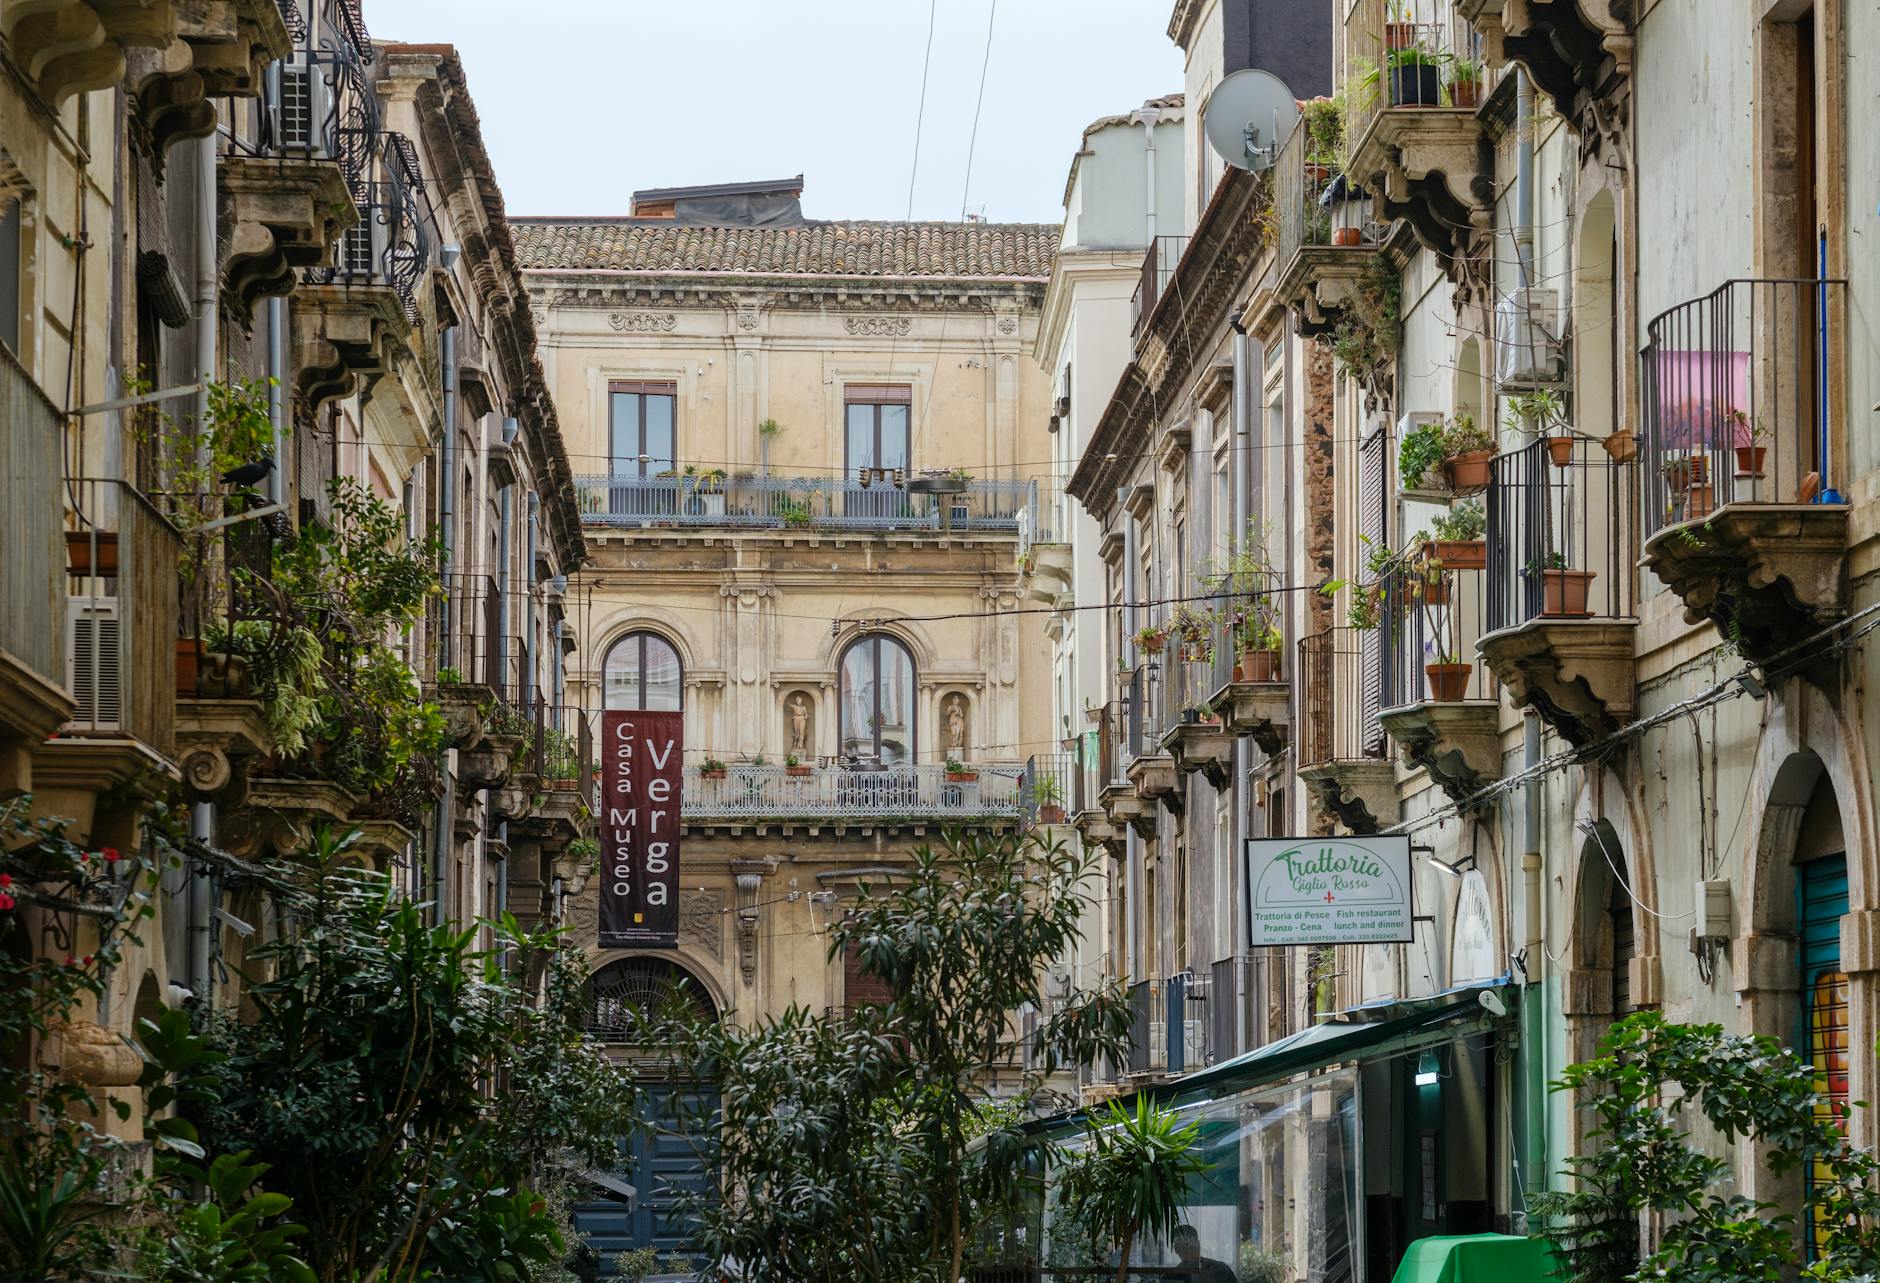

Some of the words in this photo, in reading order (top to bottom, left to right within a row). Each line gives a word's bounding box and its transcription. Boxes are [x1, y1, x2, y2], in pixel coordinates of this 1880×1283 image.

[616, 722, 635, 793] Casa
[645, 739, 675, 906] Verga
[610, 808, 637, 896] Museo
[1274, 848, 1384, 881] Trattoria
[1292, 876, 1327, 895] Giglio
[1331, 875, 1369, 891] Rosso
[1255, 912, 1292, 921] Trattoria
[1294, 911, 1302, 919] di
[1304, 911, 1330, 919] Pesce
[1337, 909, 1354, 918] Fish
[1357, 909, 1402, 917] restaurant
[1264, 924, 1293, 932] Pranzo
[1300, 922, 1322, 931] Cena
[1334, 922, 1357, 930] lunch
[1360, 920, 1376, 929] and
[1378, 919, 1404, 928] dinner
